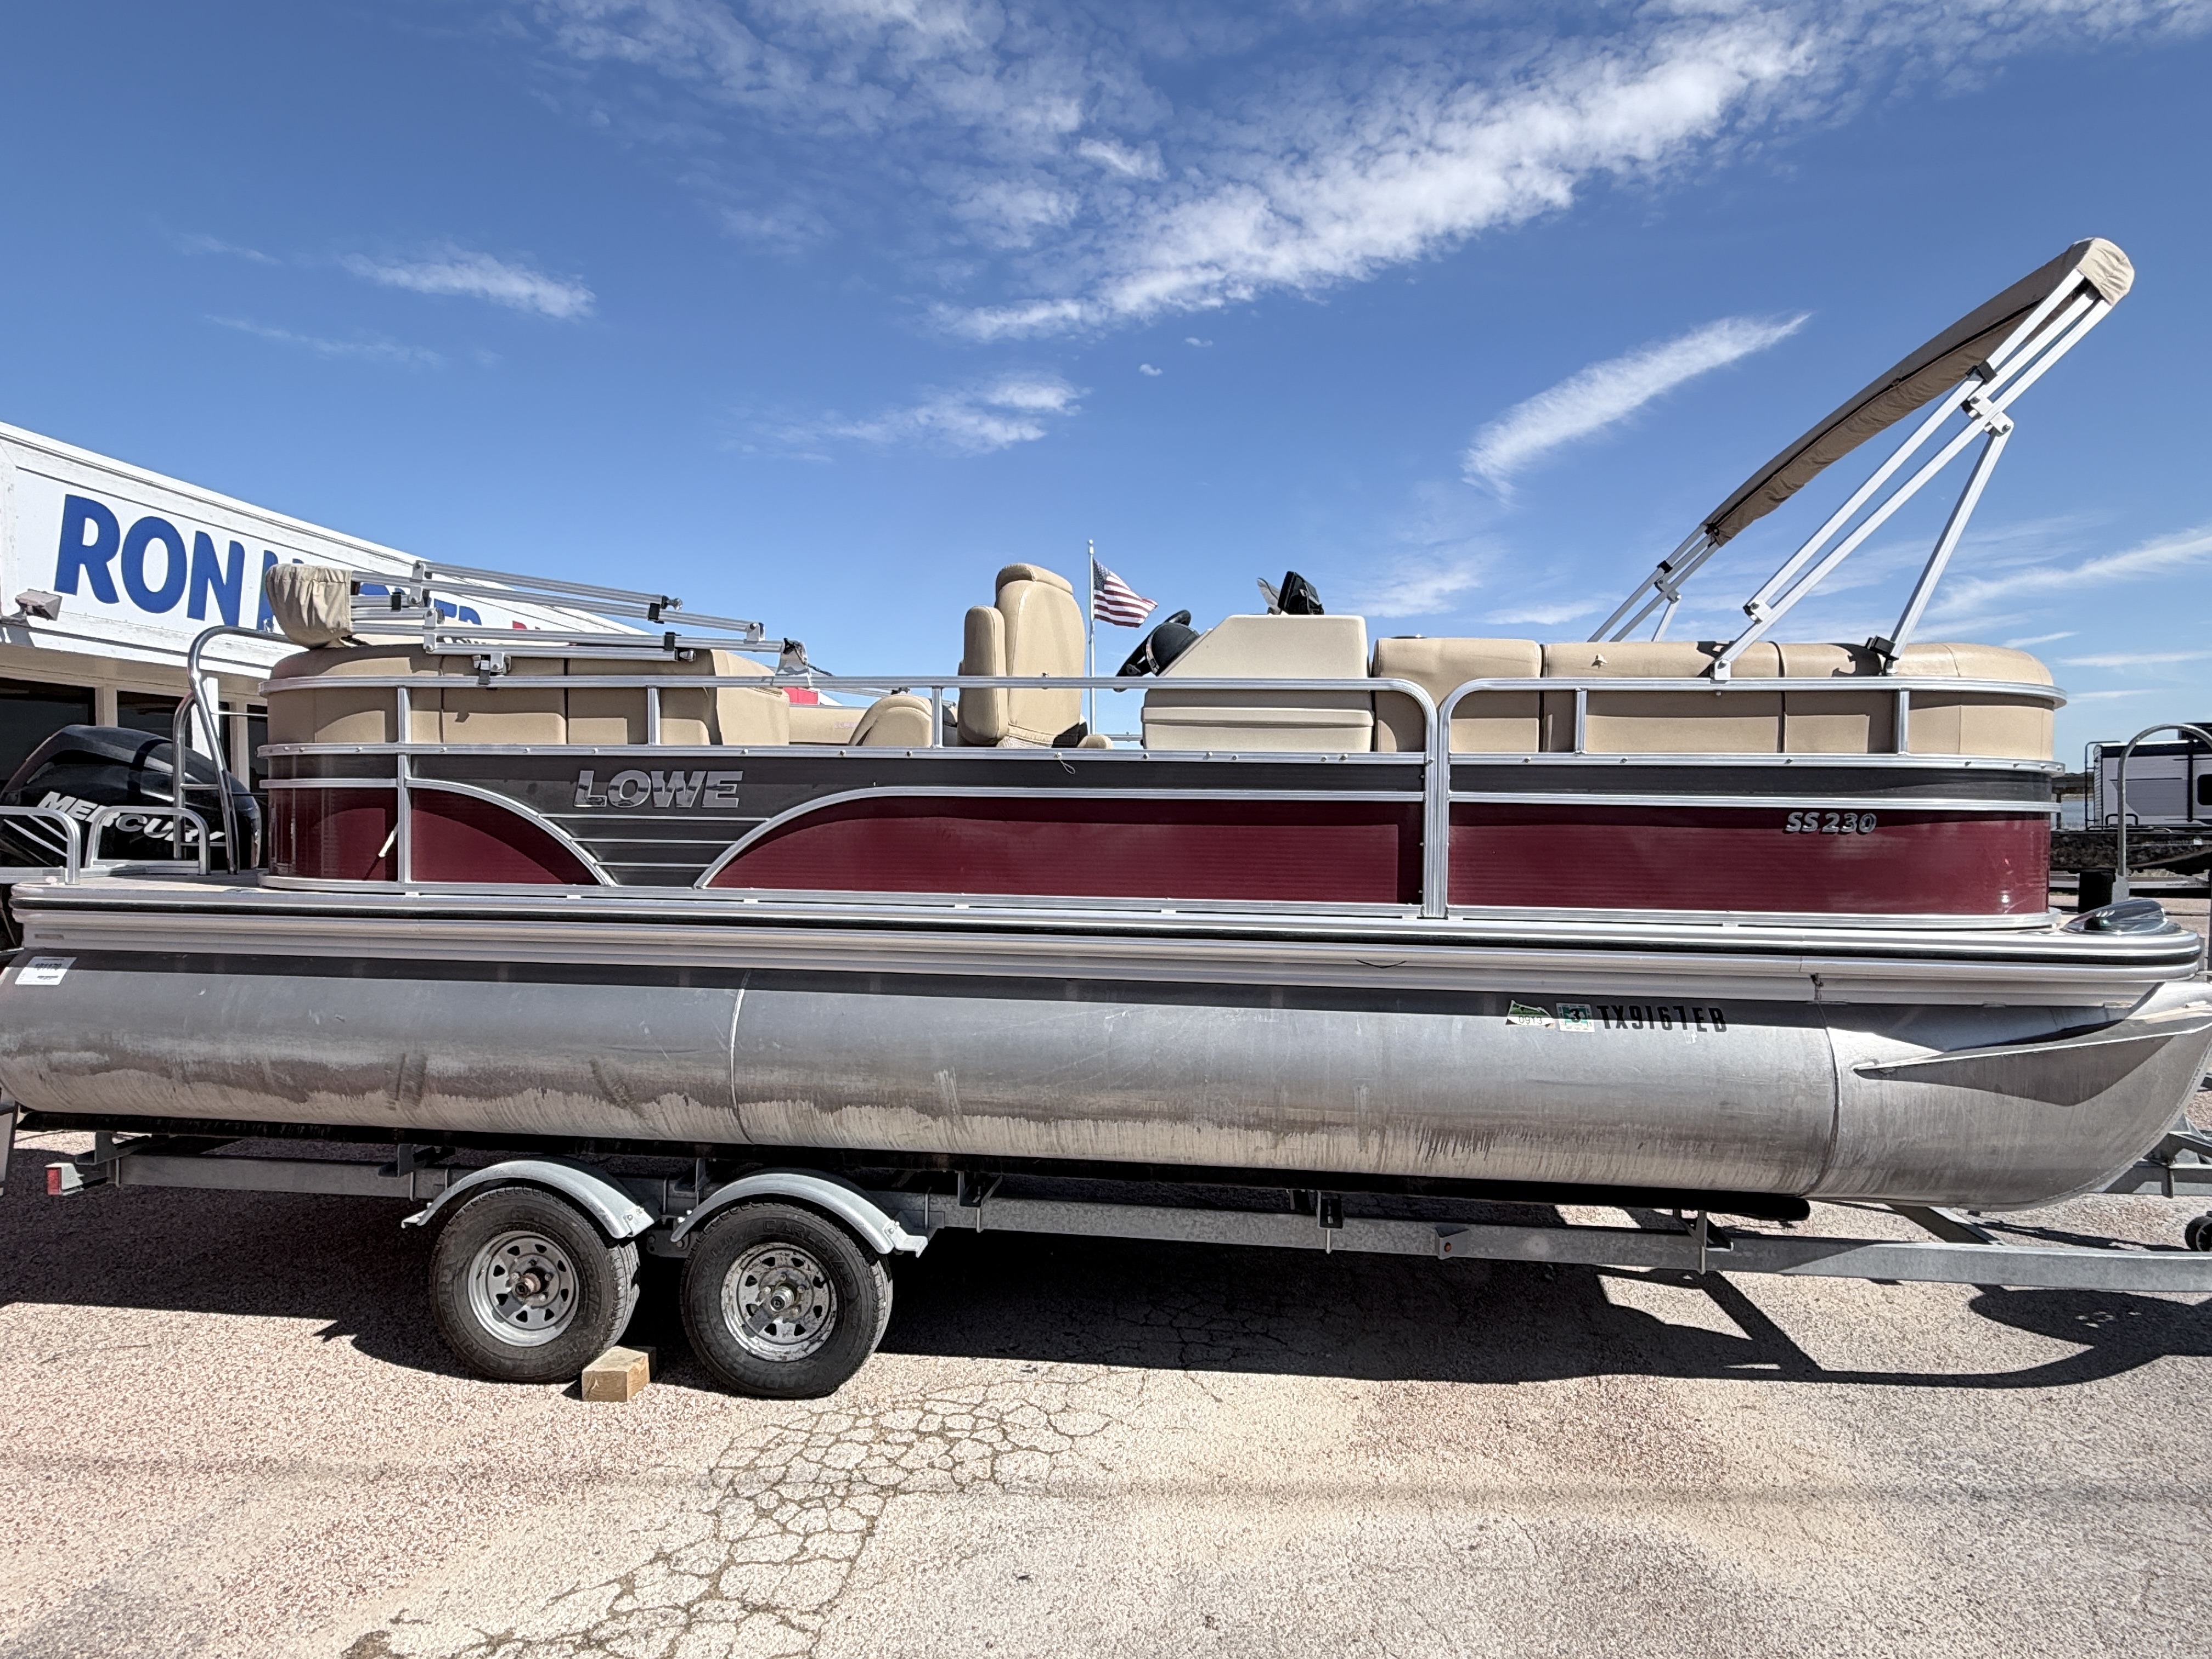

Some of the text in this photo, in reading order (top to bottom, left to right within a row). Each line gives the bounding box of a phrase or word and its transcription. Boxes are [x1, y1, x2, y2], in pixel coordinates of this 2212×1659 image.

[54, 494, 245, 626] RON
[574, 770, 743, 808] LOWE
[1785, 812, 1877, 833] SS 230
[763, 1219, 853, 1288] CARLSTAR
